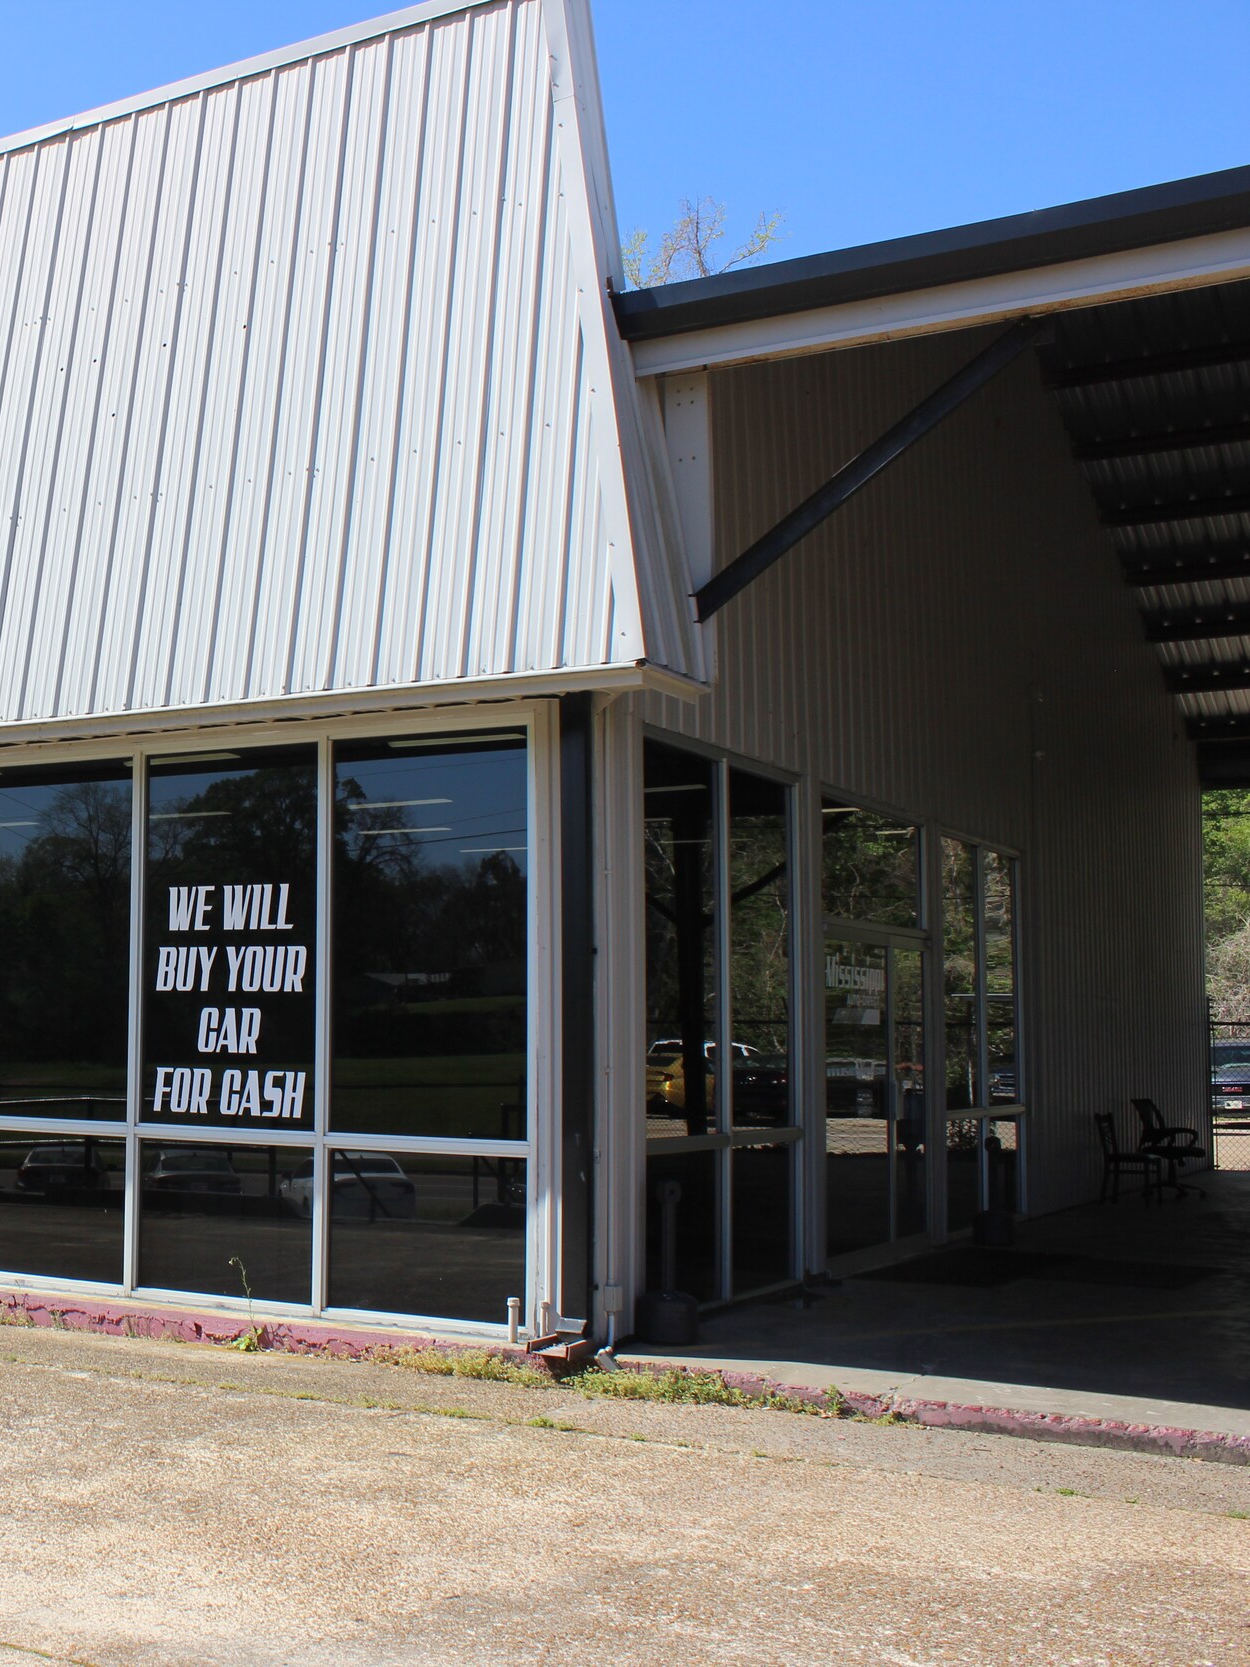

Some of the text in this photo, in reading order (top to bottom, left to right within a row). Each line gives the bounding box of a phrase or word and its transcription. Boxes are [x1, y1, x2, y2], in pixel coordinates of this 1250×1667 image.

[169, 884, 294, 931] WE WILL
[156, 945, 307, 992] BUY YOUR
[197, 1007, 261, 1054] CAR
[153, 1067, 306, 1118] FOR CASH
